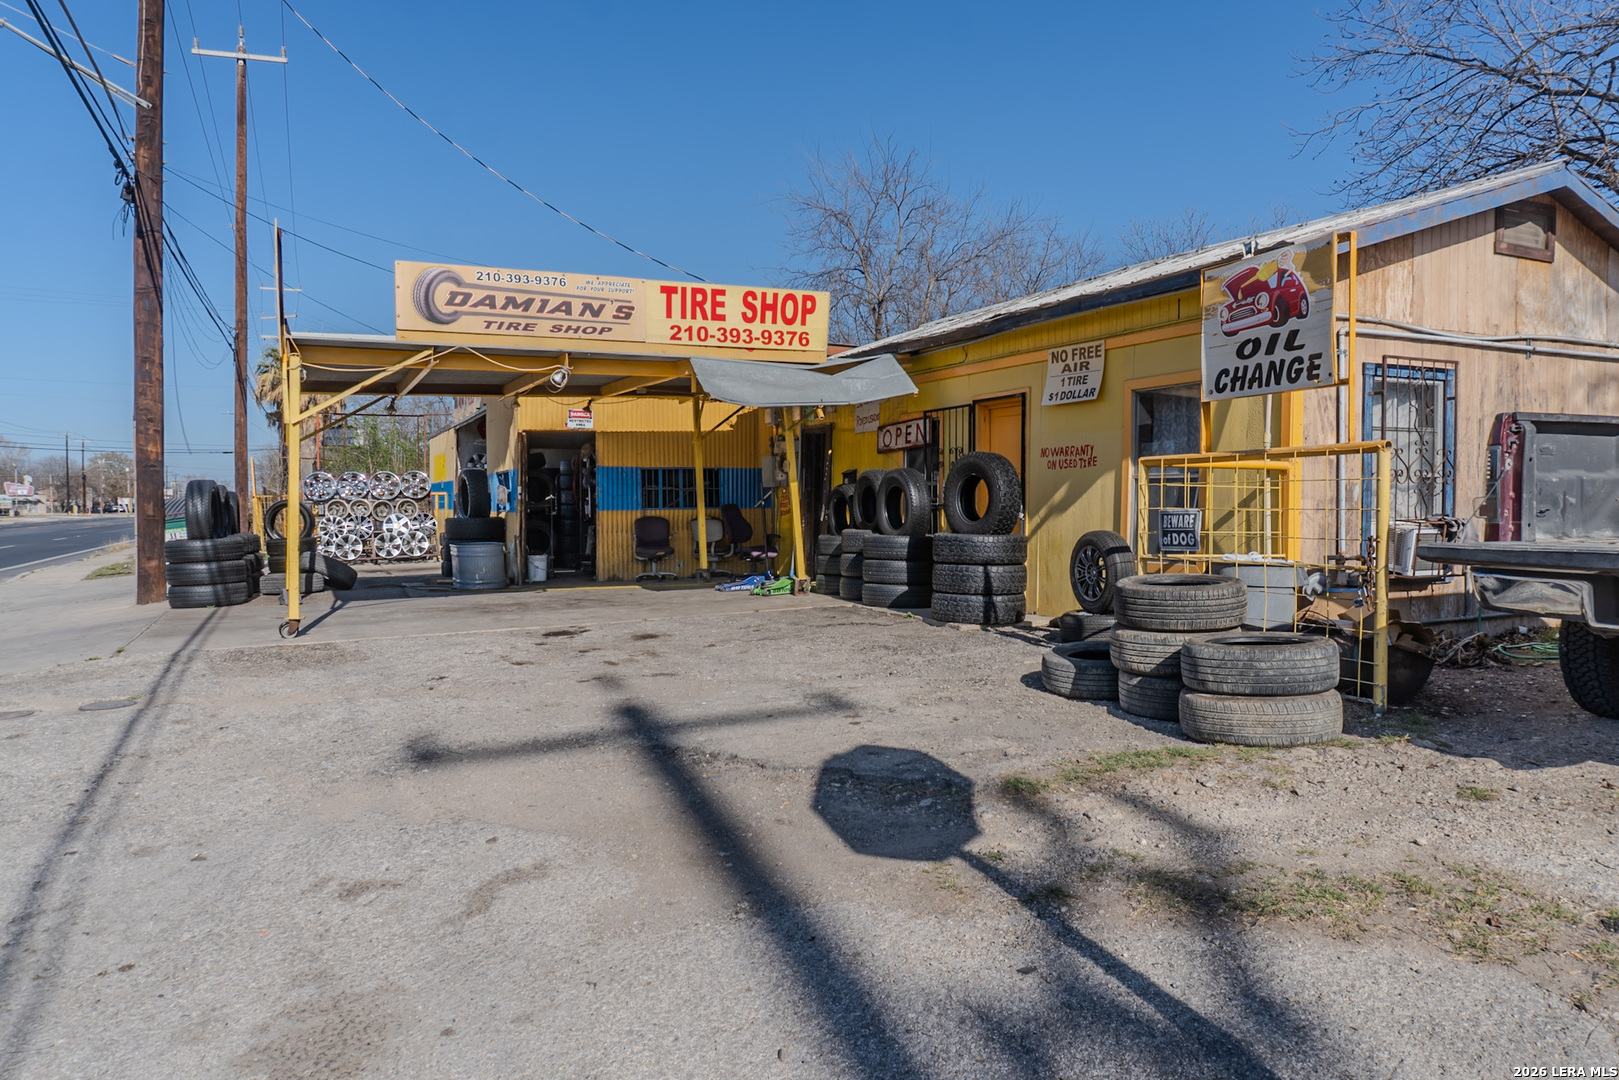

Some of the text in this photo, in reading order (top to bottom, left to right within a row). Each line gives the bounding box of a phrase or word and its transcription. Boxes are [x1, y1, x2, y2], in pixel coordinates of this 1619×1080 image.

[476, 271, 567, 288] 210-393-9376
[443, 290, 636, 321] DAMIAN'S
[660, 285, 817, 326] TIRE SHOP
[483, 320, 613, 336] TIRE SHOP
[669, 324, 810, 347] 210-393-9376
[1235, 329, 1306, 360] OIL
[1051, 344, 1102, 364] NO FREE
[1061, 361, 1090, 374] AIR
[1214, 352, 1323, 394] CHANGE
[1067, 374, 1089, 386] TIRE
[1060, 387, 1097, 401] DOLLAR
[882, 423, 925, 448] OPEN
[1040, 444, 1095, 458] NO WARRANTY
[1047, 456, 1098, 470] ON USED TIRE
[1163, 514, 1195, 528] BEWARE
[1163, 532, 1195, 546] of DOG
